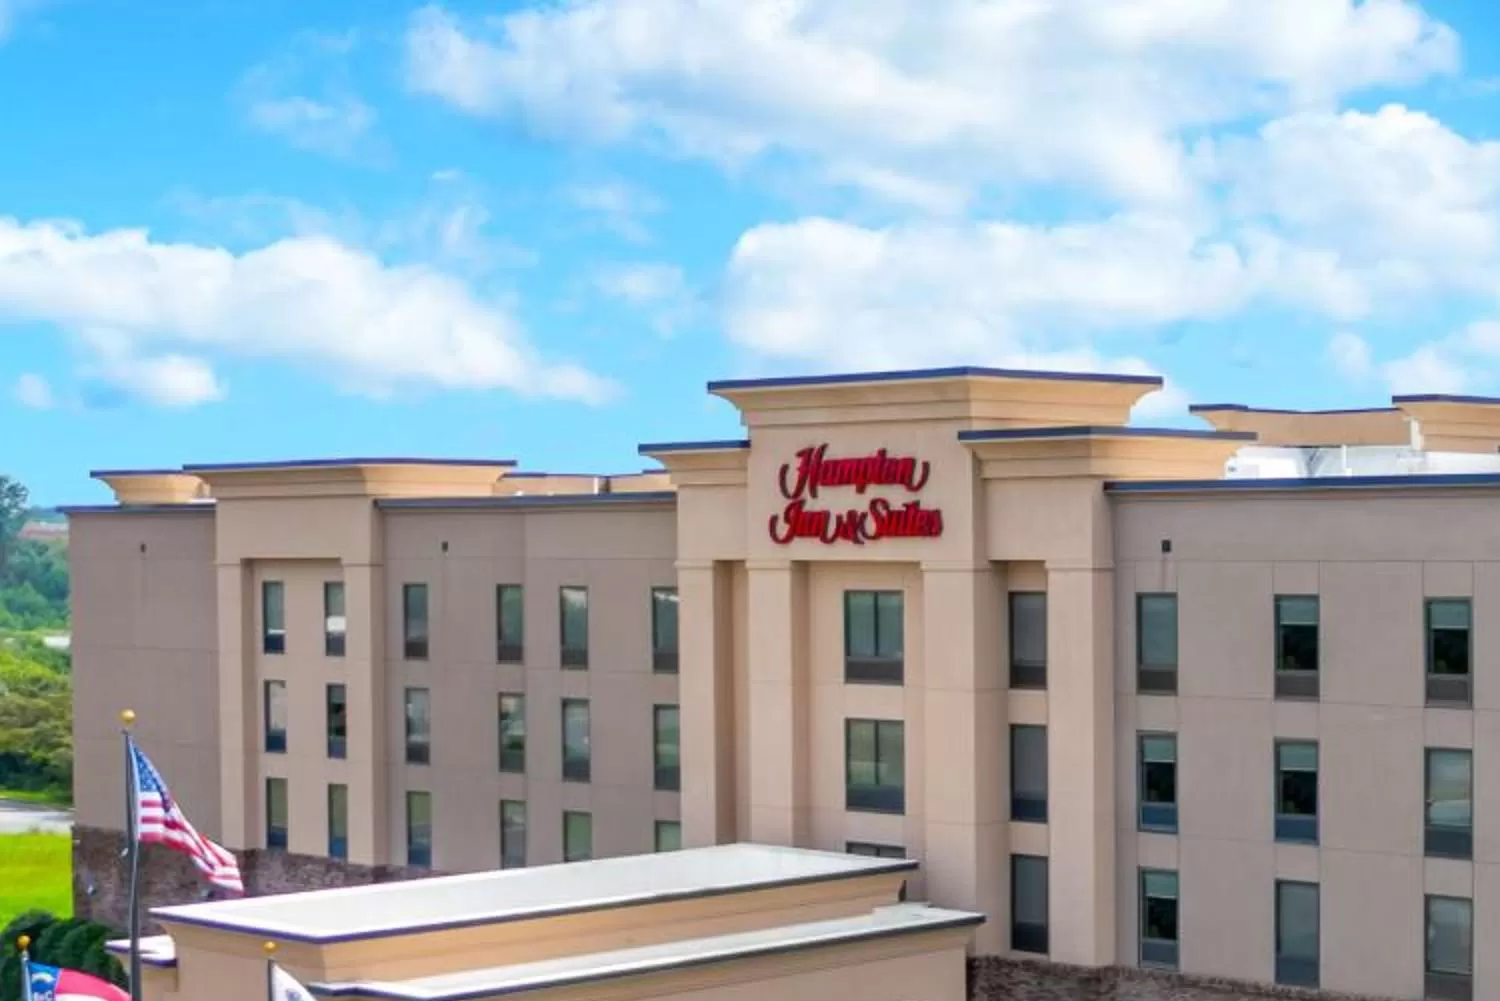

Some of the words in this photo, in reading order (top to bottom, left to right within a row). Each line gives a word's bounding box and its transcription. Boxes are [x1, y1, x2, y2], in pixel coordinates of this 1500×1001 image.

[779, 443, 930, 499] Hampton
[769, 500, 840, 544] Inn
[862, 498, 943, 540] Suites
